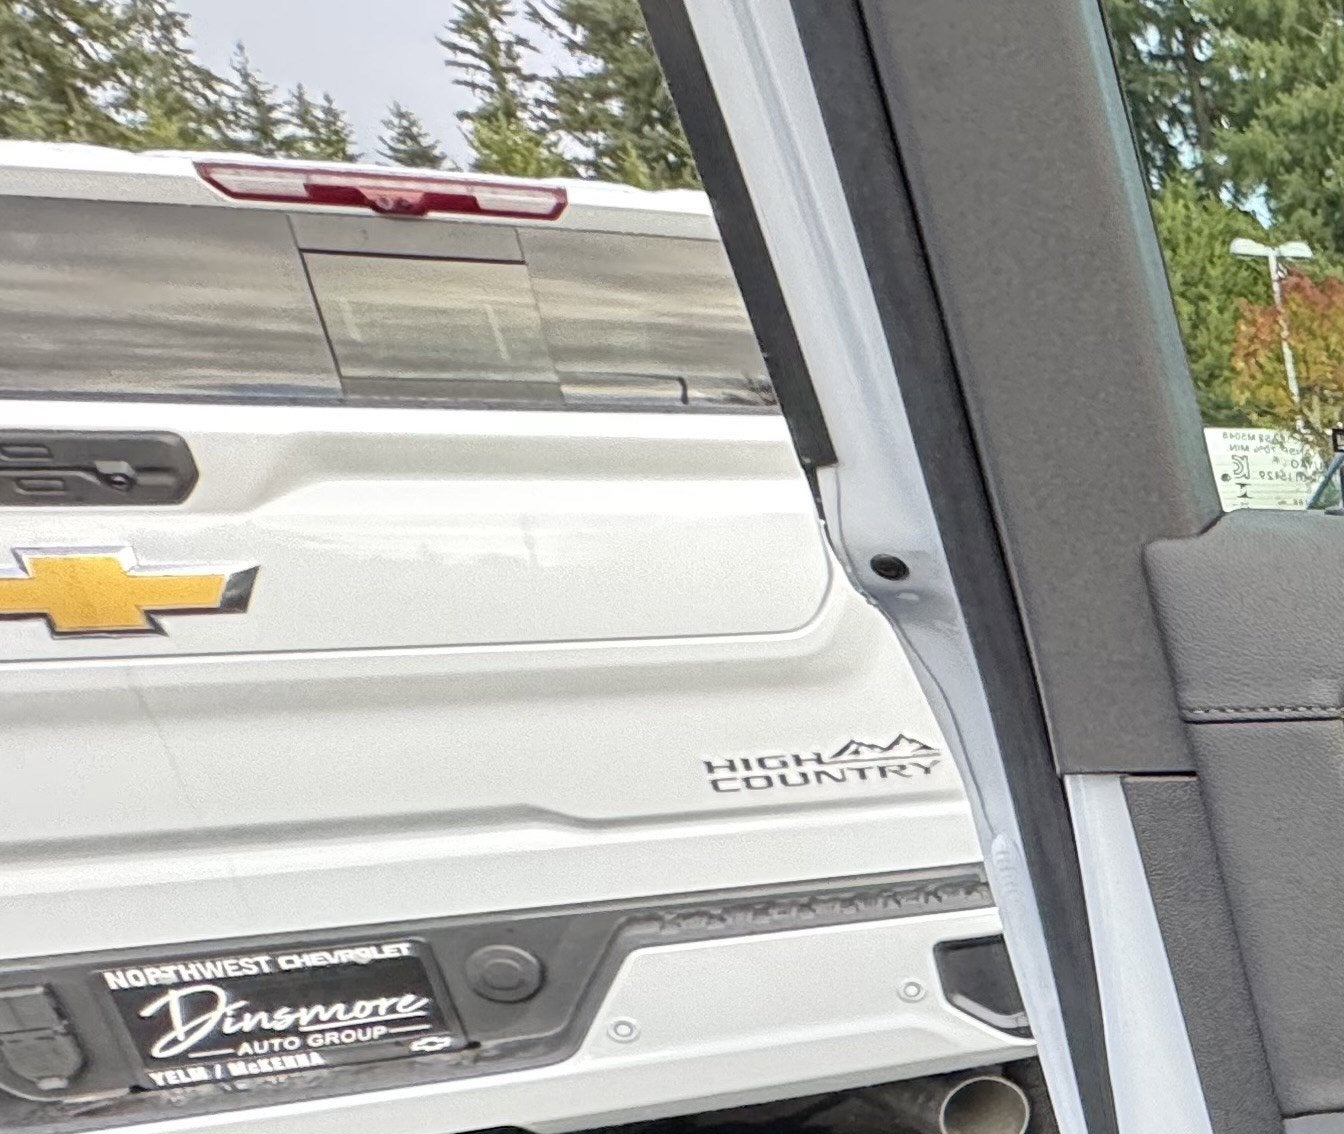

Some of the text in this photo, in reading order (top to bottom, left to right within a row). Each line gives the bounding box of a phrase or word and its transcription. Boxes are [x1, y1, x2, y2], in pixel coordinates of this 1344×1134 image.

[704, 752, 825, 774] HIGH
[709, 759, 942, 793] COUNTRY
[103, 942, 413, 990] NORTHWEST CHEVROLET
[139, 984, 431, 1058] Dinsmore
[237, 1025, 388, 1057] AUTO GROUP
[149, 1066, 209, 1086] YELM
[227, 1051, 326, 1076] McKENNA
